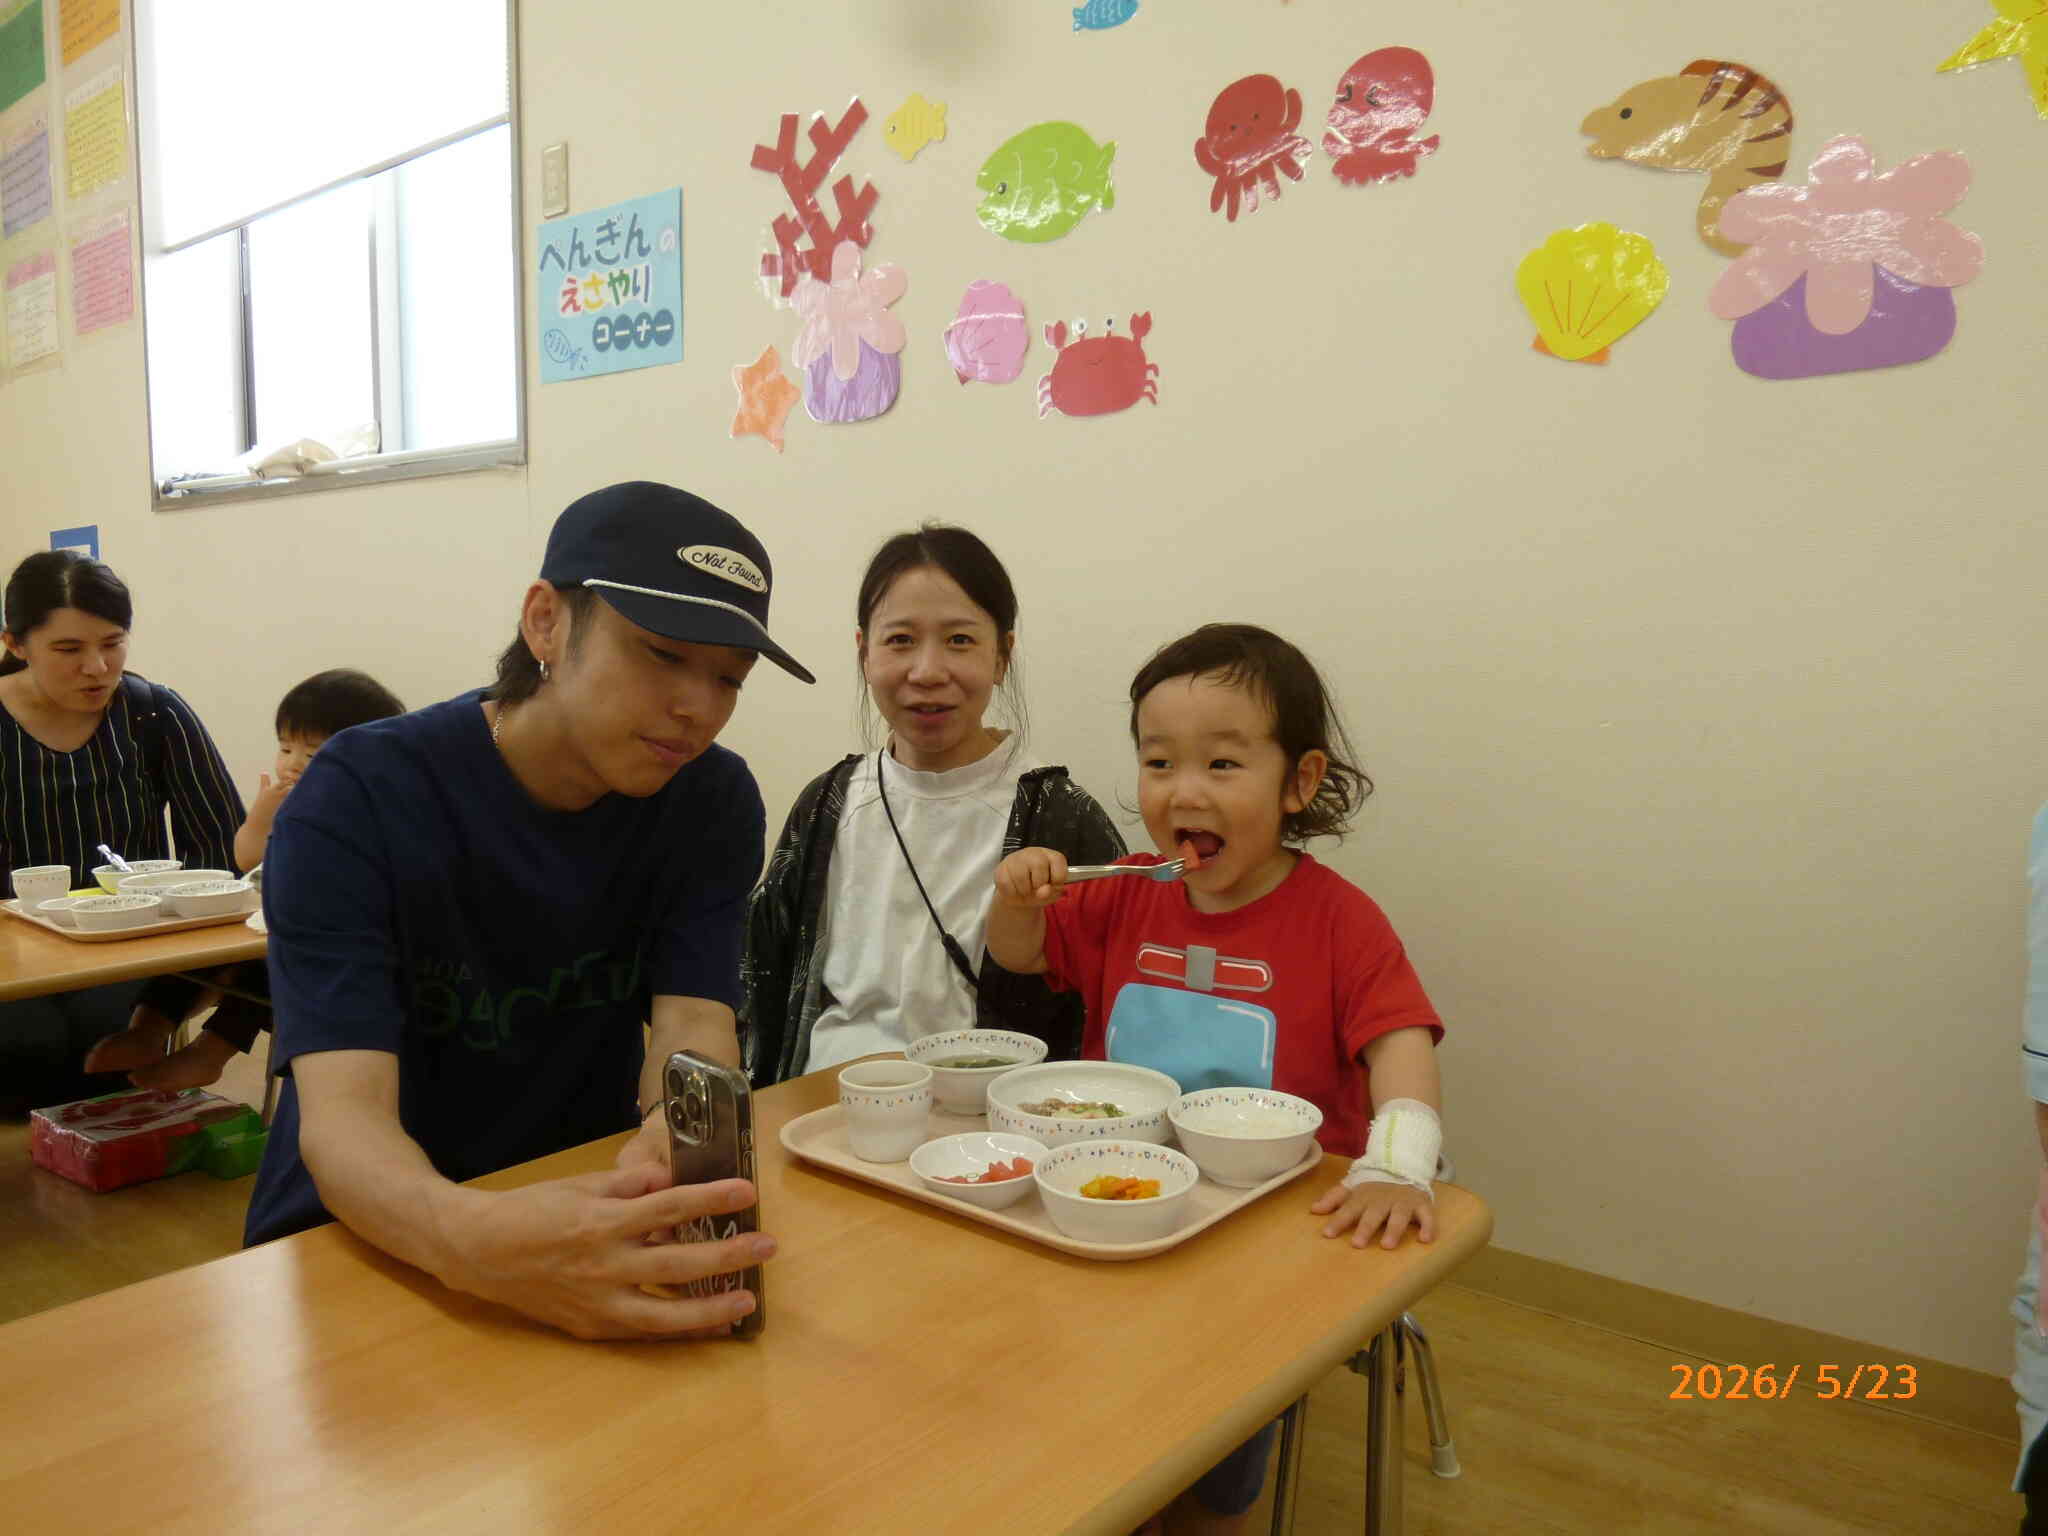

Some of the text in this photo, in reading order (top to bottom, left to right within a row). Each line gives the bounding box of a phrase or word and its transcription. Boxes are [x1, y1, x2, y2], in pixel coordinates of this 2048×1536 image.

[561, 265, 650, 312] えさやり
[595, 316, 672, 345] コーナー
[692, 552, 727, 569] Not
